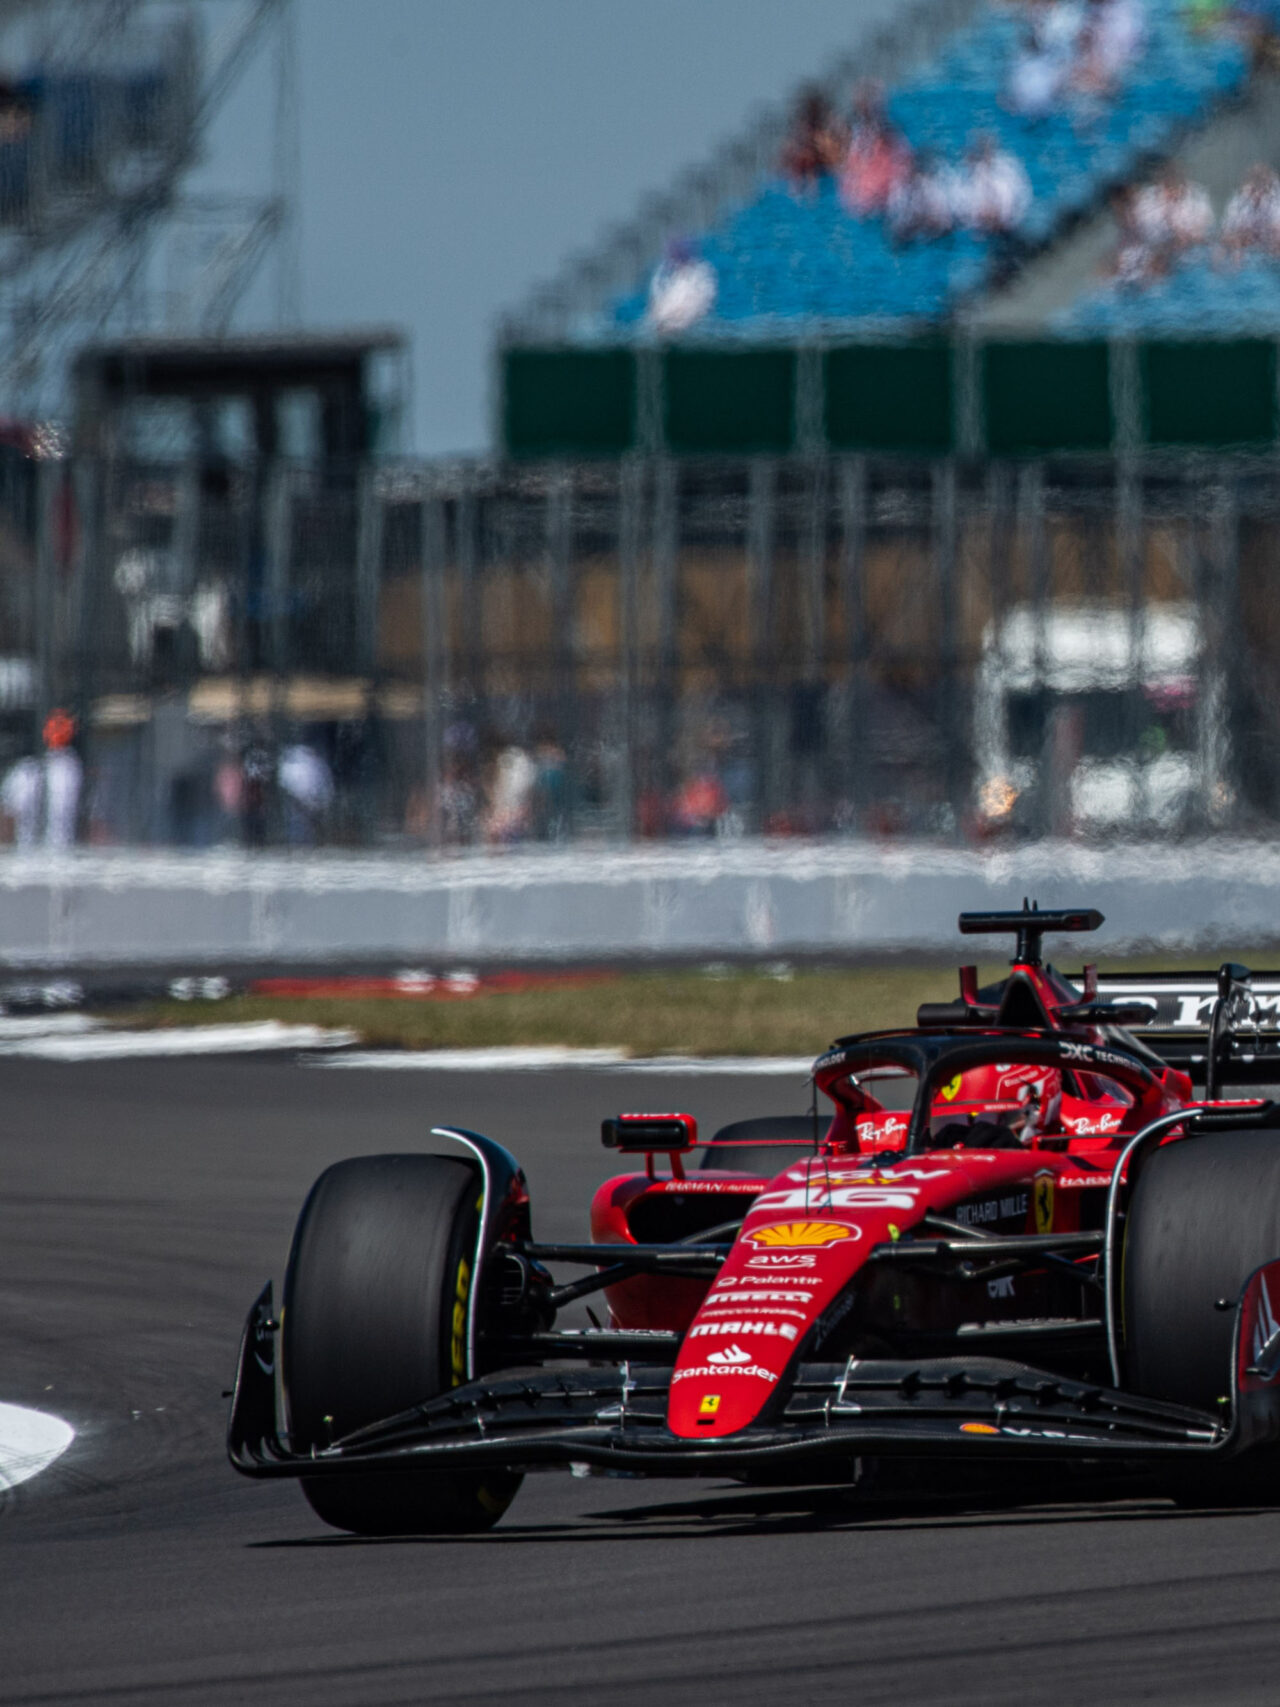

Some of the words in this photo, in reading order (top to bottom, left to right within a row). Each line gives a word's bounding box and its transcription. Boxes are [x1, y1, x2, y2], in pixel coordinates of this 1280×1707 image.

[746, 1187, 921, 1216] 16
[956, 1201, 999, 1225] RICHARD
[1000, 1193, 1028, 1218] MILLE
[749, 1254, 817, 1265] aws
[740, 1274, 822, 1285] Palantir
[705, 1290, 814, 1305] PIRELLI
[690, 1321, 798, 1341] MAHLE
[672, 1364, 779, 1384] Santander
